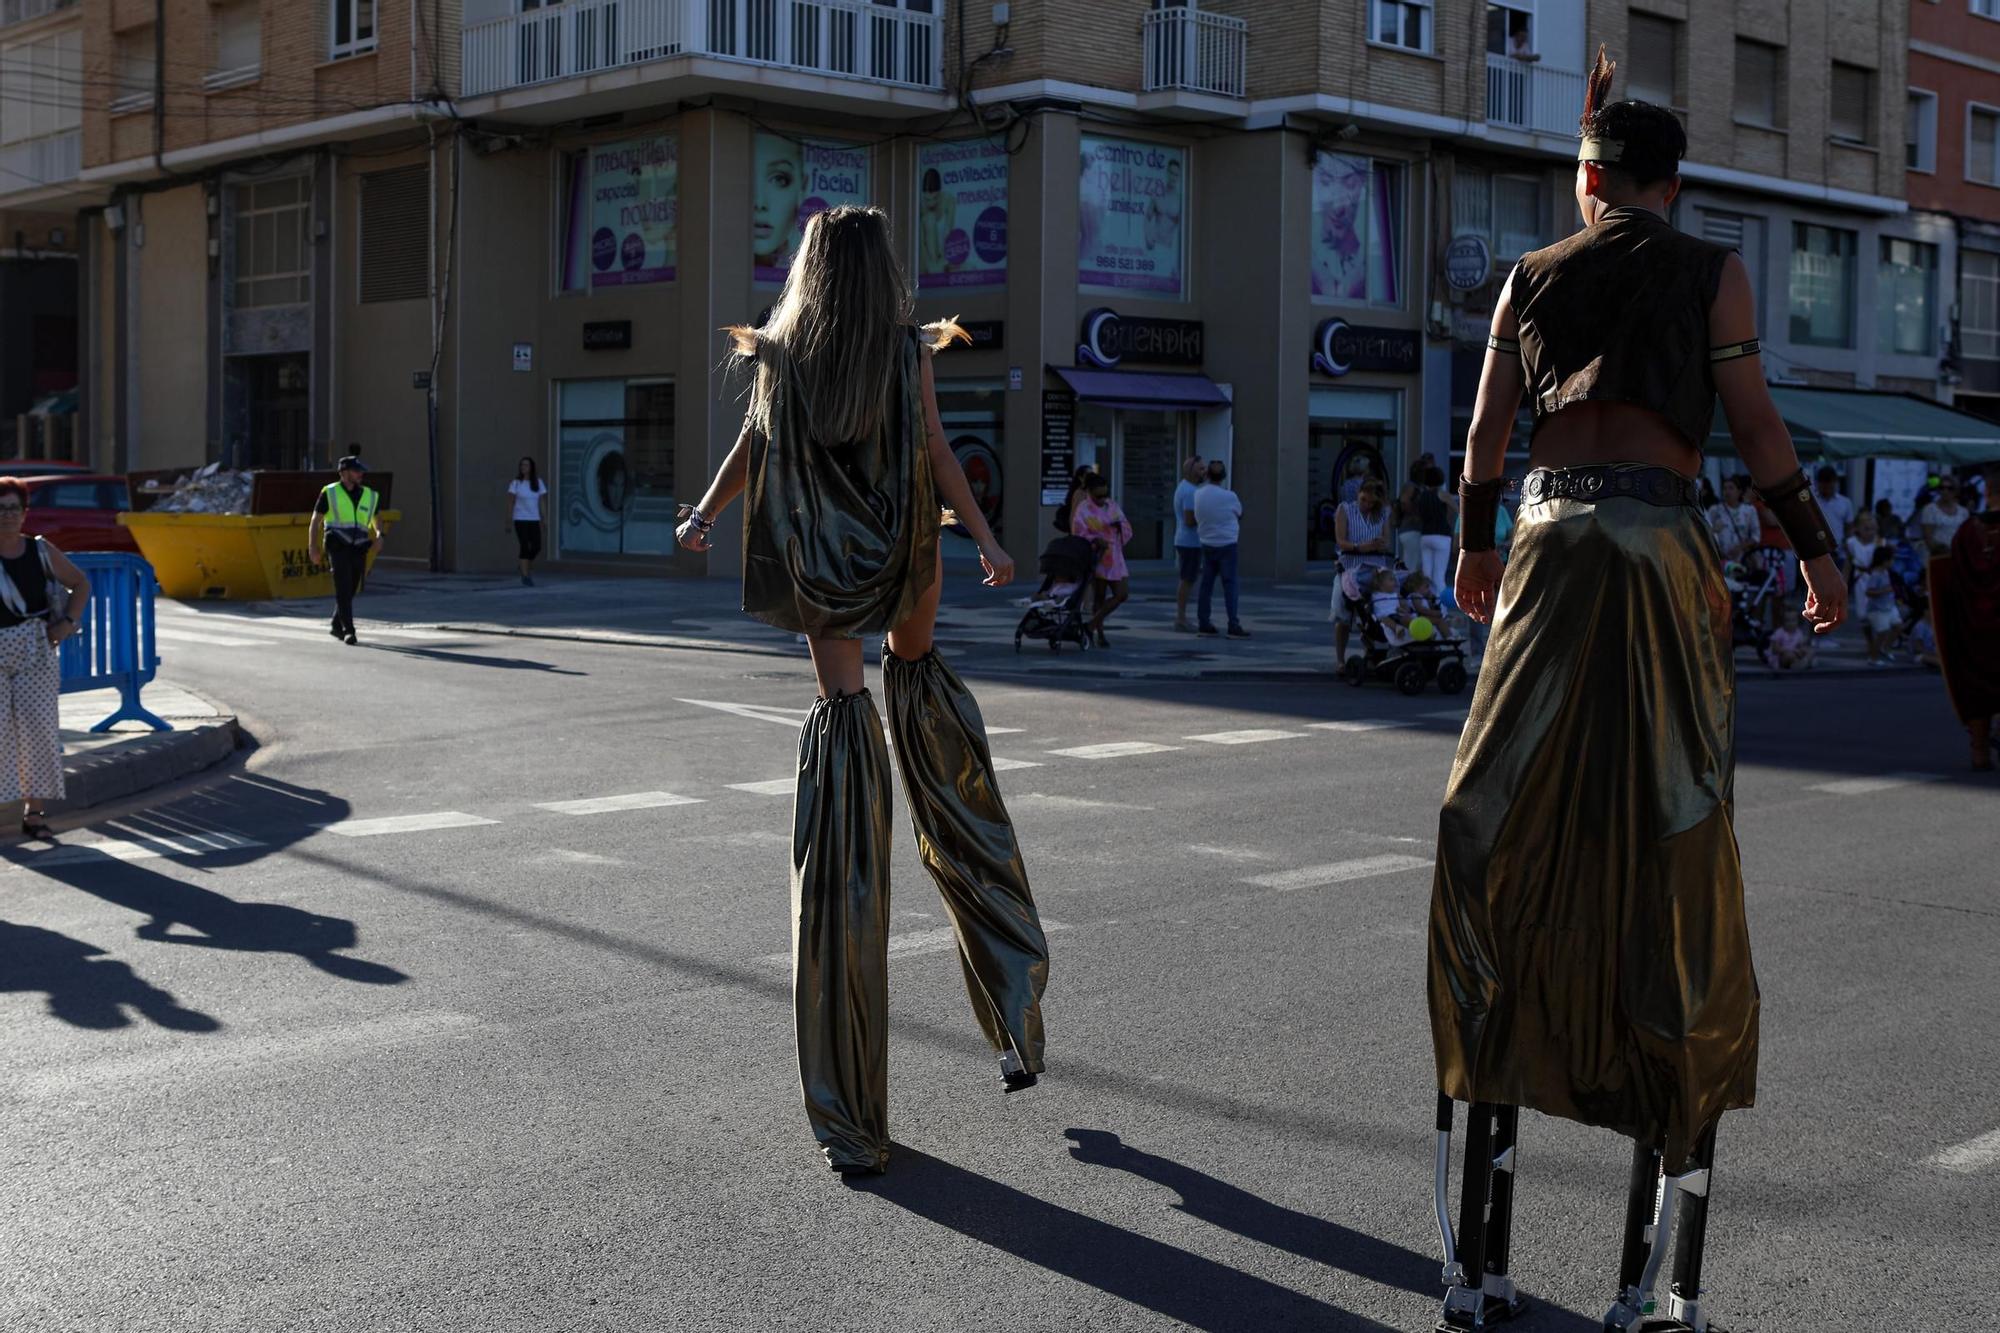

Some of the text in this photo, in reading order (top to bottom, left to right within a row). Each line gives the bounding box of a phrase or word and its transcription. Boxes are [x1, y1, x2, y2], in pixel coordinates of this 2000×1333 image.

[806, 144, 864, 170] higiene
[1096, 144, 1166, 169] centro de
[596, 181, 640, 204] especial
[811, 168, 859, 194] facial
[1098, 166, 1167, 197] belleza
[620, 198, 677, 226] novias
